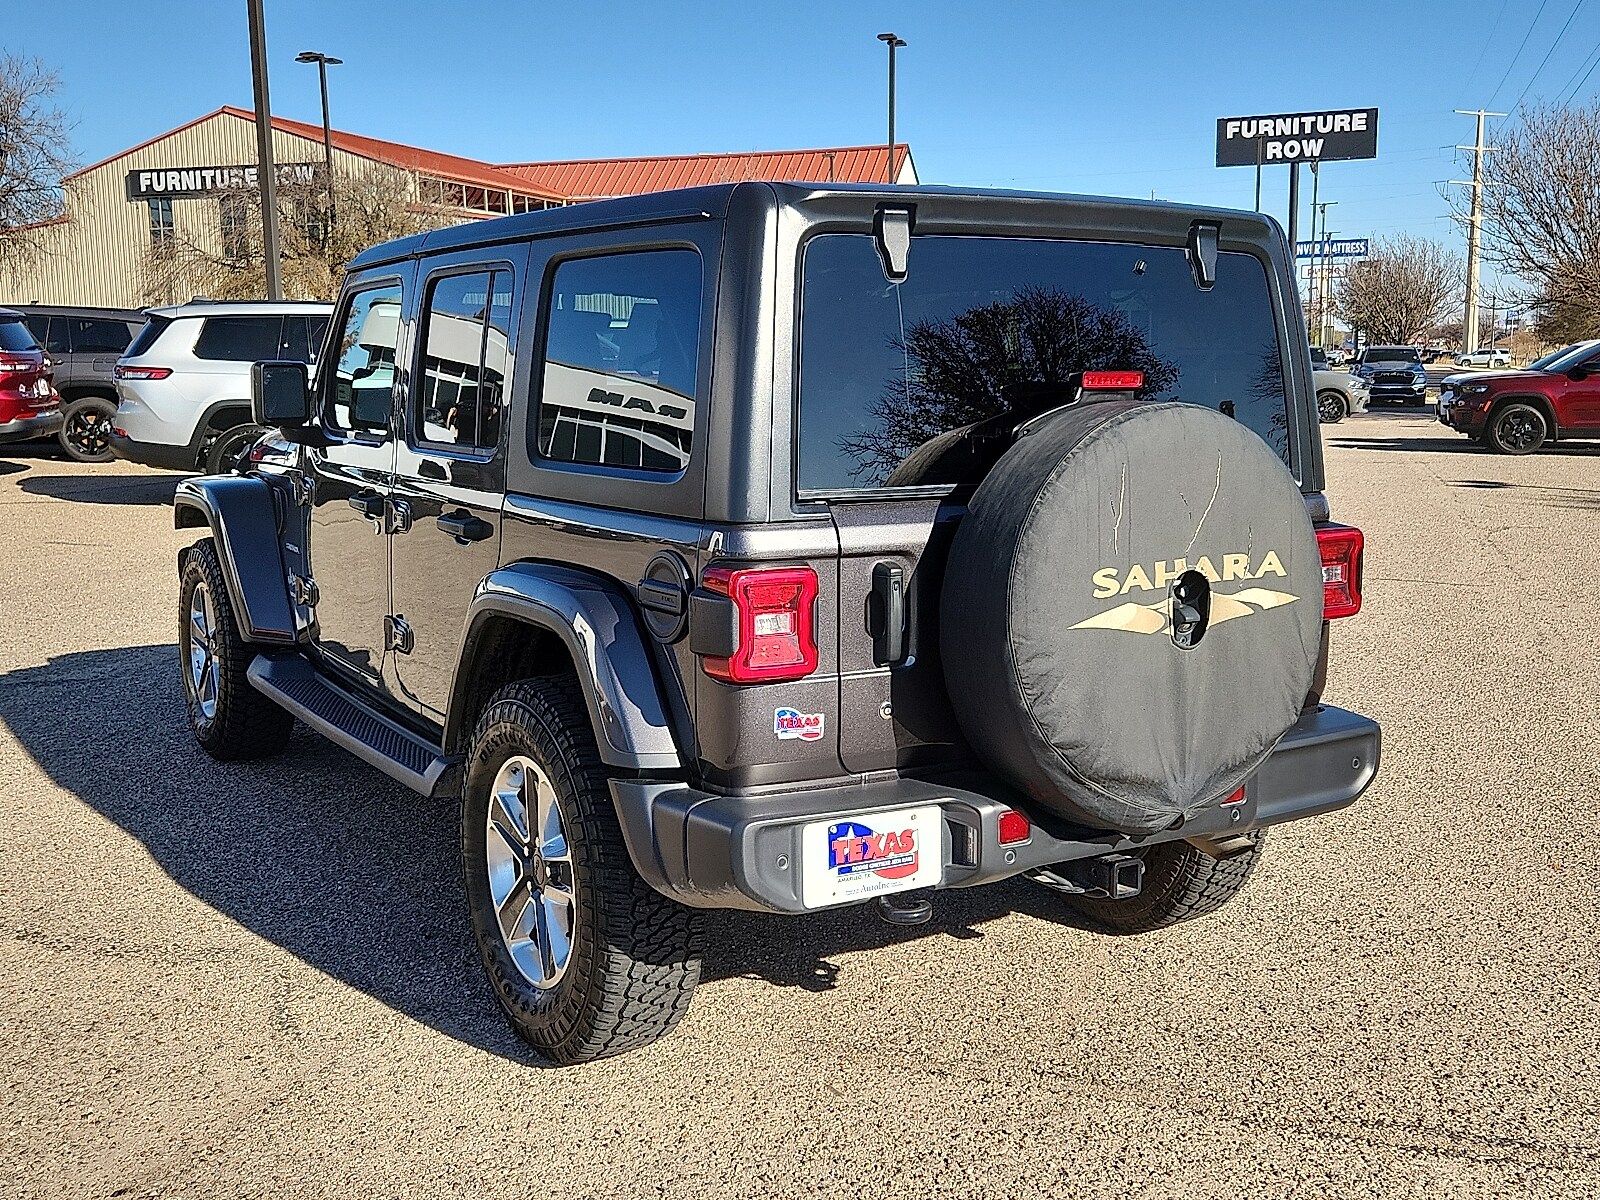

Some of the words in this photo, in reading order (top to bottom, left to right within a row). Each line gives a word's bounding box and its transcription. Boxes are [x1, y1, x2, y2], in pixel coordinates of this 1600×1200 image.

[1226, 112, 1368, 139] FURNITURE
[1266, 138, 1325, 160] ROW
[139, 168, 258, 192] FURNITURE
[1296, 243, 1321, 256] NVR
[1323, 241, 1365, 255] MATTRESS
[1092, 550, 1288, 600] SAHARA
[778, 715, 820, 729] TEXAS
[831, 829, 915, 865] TEXAS
